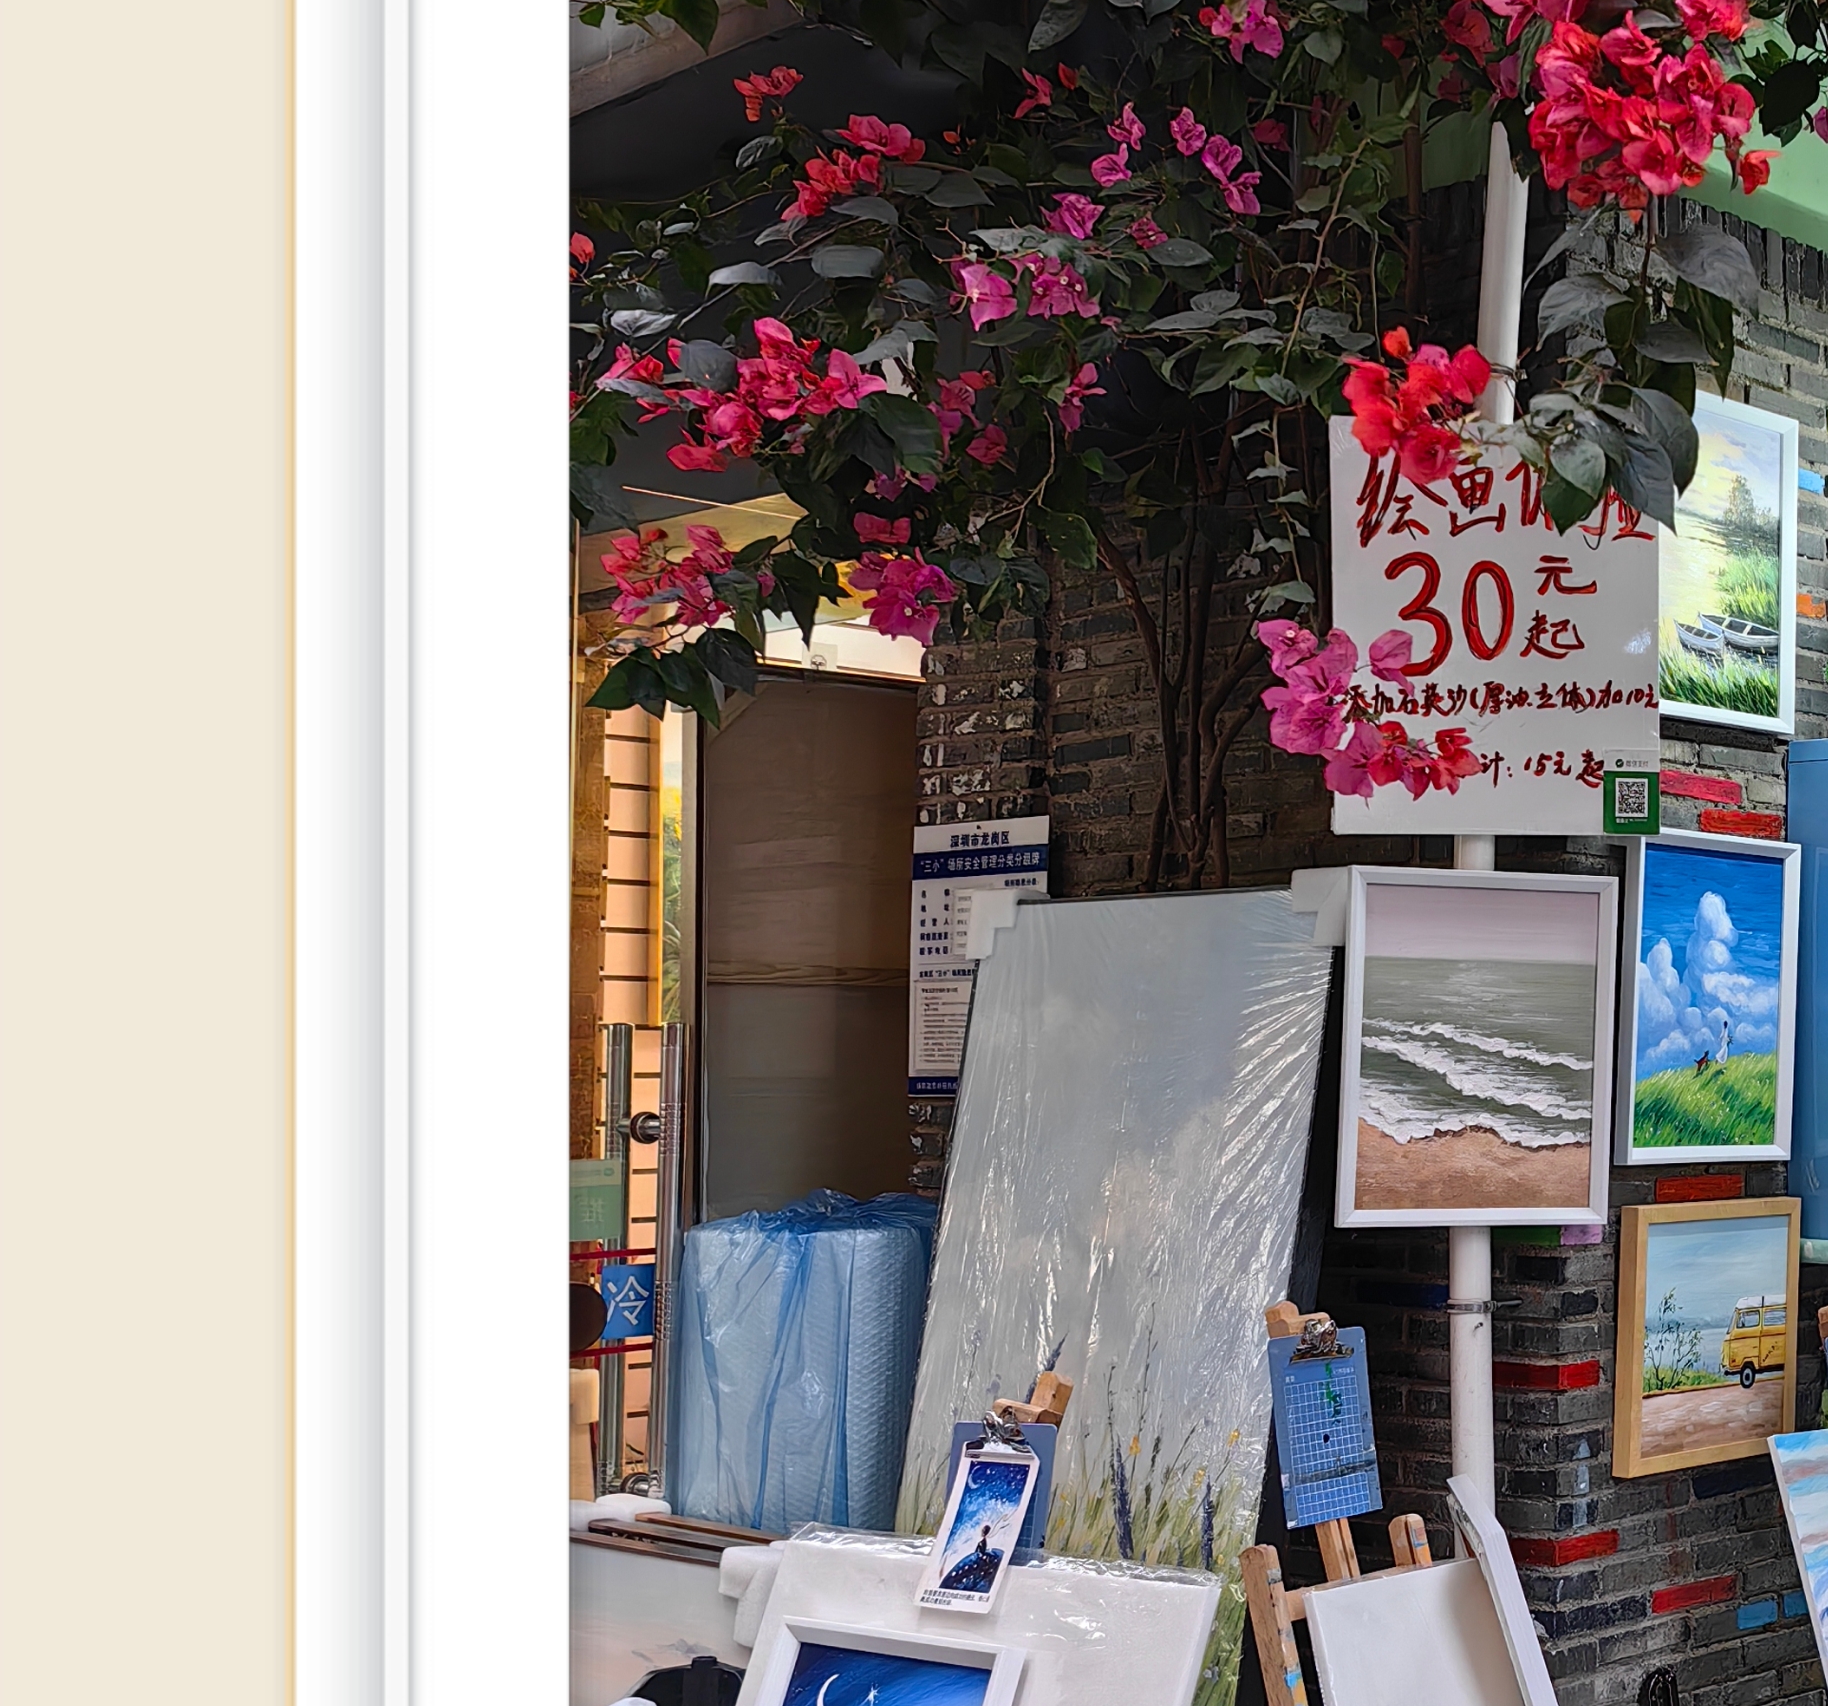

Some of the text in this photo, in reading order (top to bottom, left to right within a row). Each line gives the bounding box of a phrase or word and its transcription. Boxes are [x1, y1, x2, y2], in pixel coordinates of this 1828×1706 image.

[1384, 551, 1514, 677] 30
[950, 830, 1010, 848] 深圳市龙岗区
[606, 1275, 650, 1326] 冷
